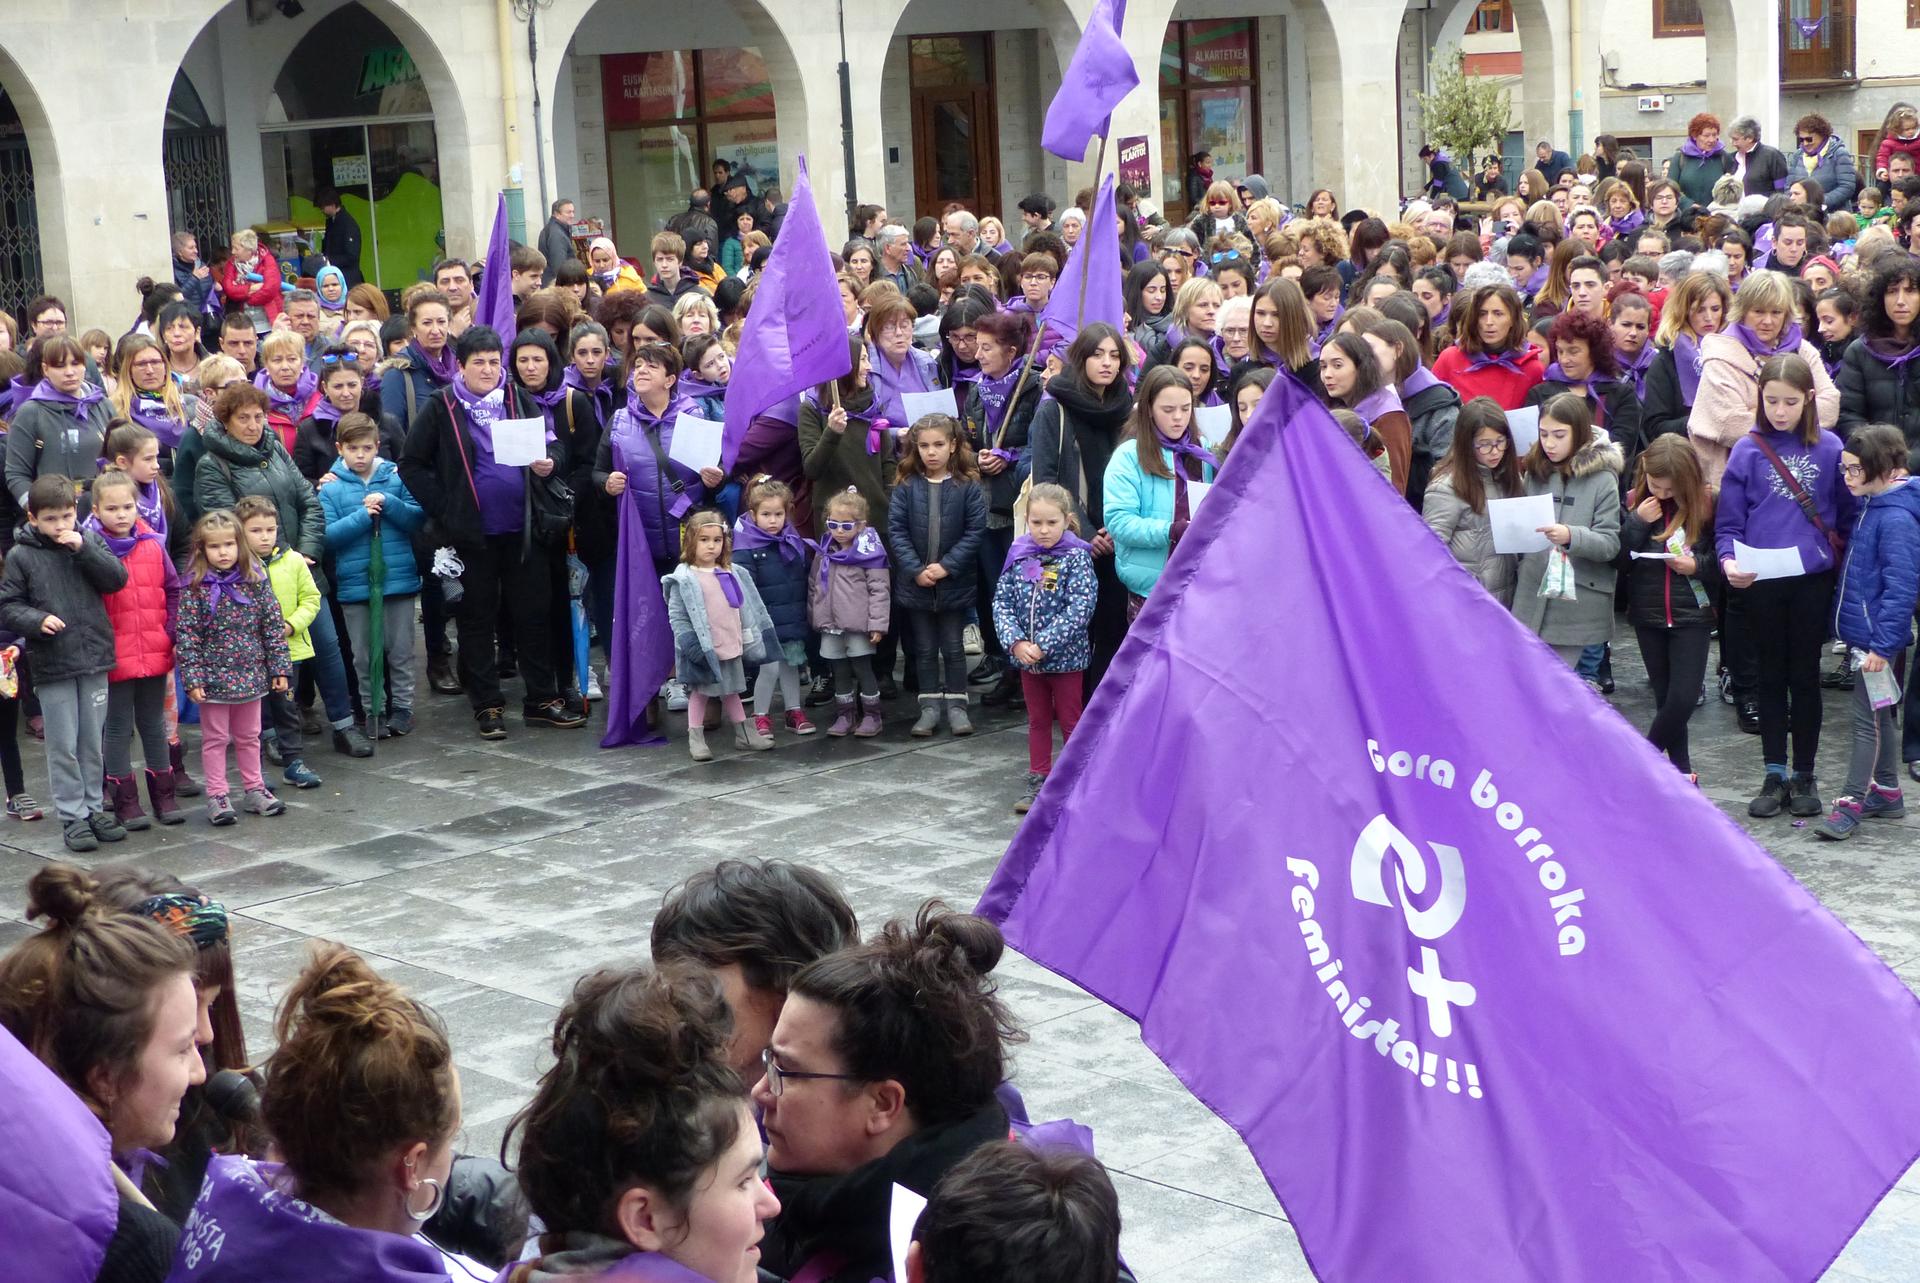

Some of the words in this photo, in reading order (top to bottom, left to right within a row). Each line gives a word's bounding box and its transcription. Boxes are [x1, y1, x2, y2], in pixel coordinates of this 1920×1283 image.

[1195, 48, 1248, 62] ALKARTETXEA
[622, 74, 649, 86] EUSKO
[1367, 739, 1456, 790] Gora
[1470, 768, 1586, 956] borroka
